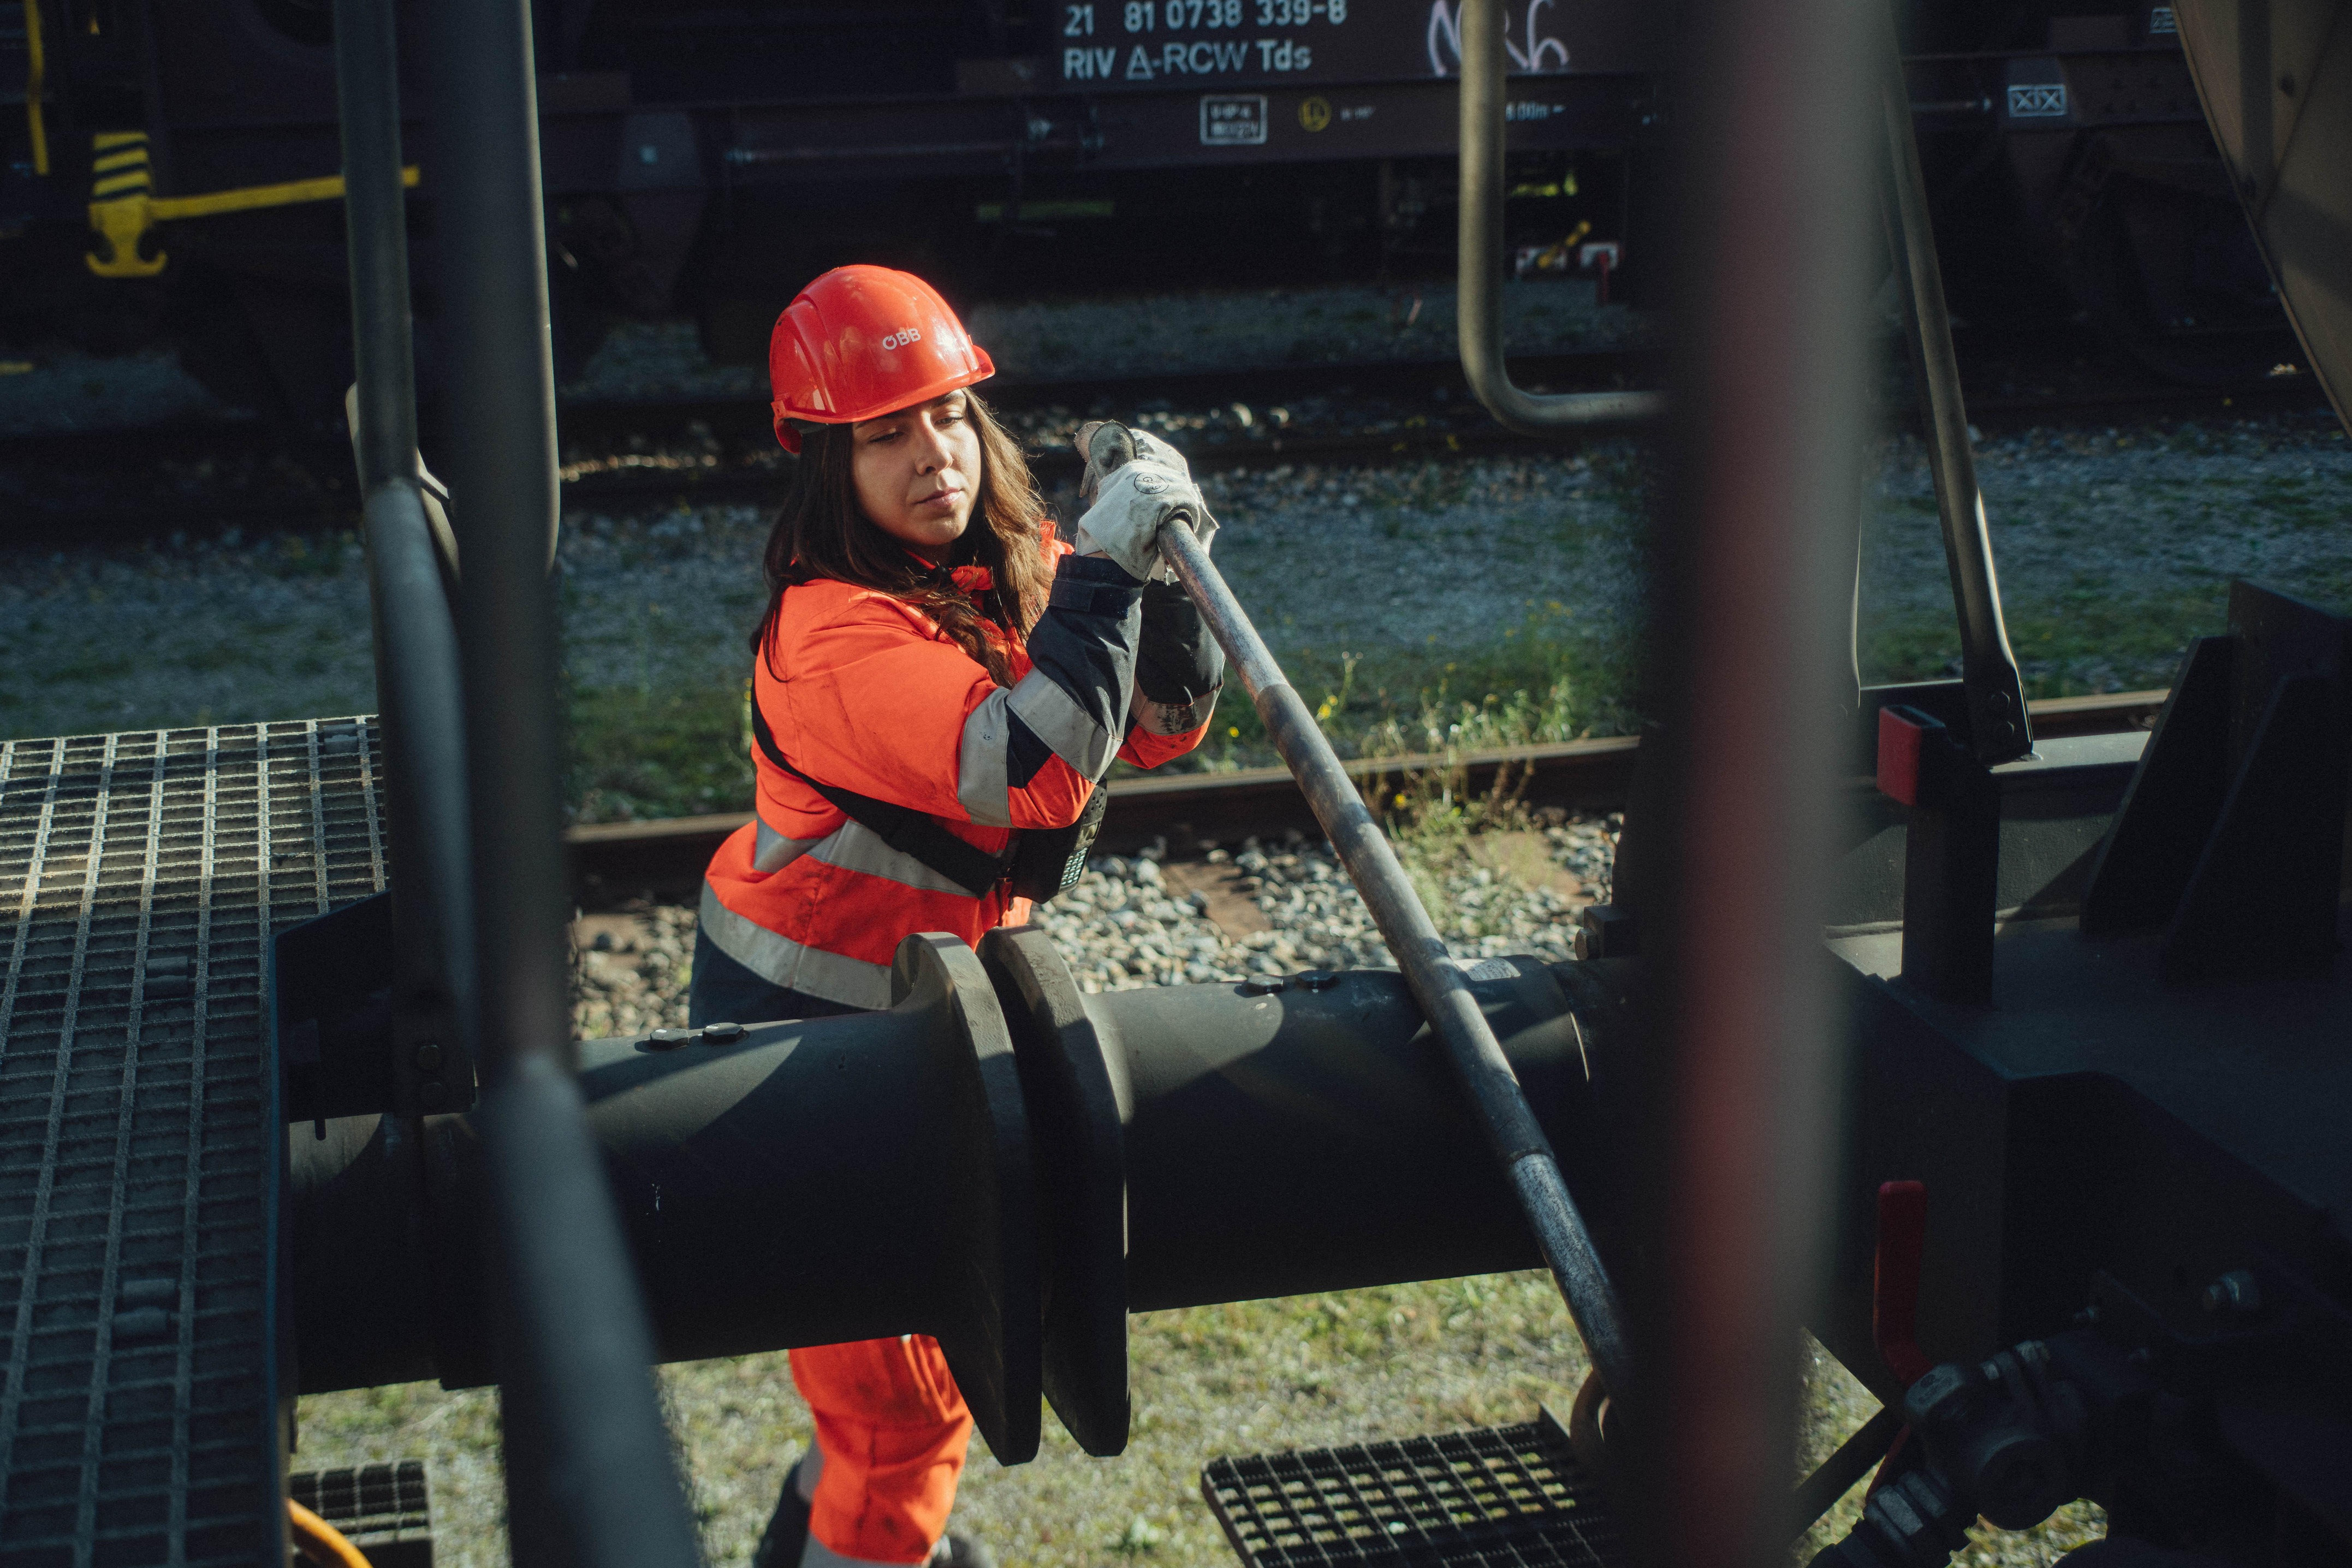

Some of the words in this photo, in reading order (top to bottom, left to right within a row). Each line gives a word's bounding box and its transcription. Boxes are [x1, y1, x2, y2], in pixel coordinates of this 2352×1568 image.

[1064, 4, 1094, 37] 21
[1124, 1, 1155, 33] 81
[1165, 0, 1243, 29] 0738
[1256, 0, 1347, 26] 339-8
[1064, 46, 1117, 80] RIV
[1256, 38, 1312, 72] Tds
